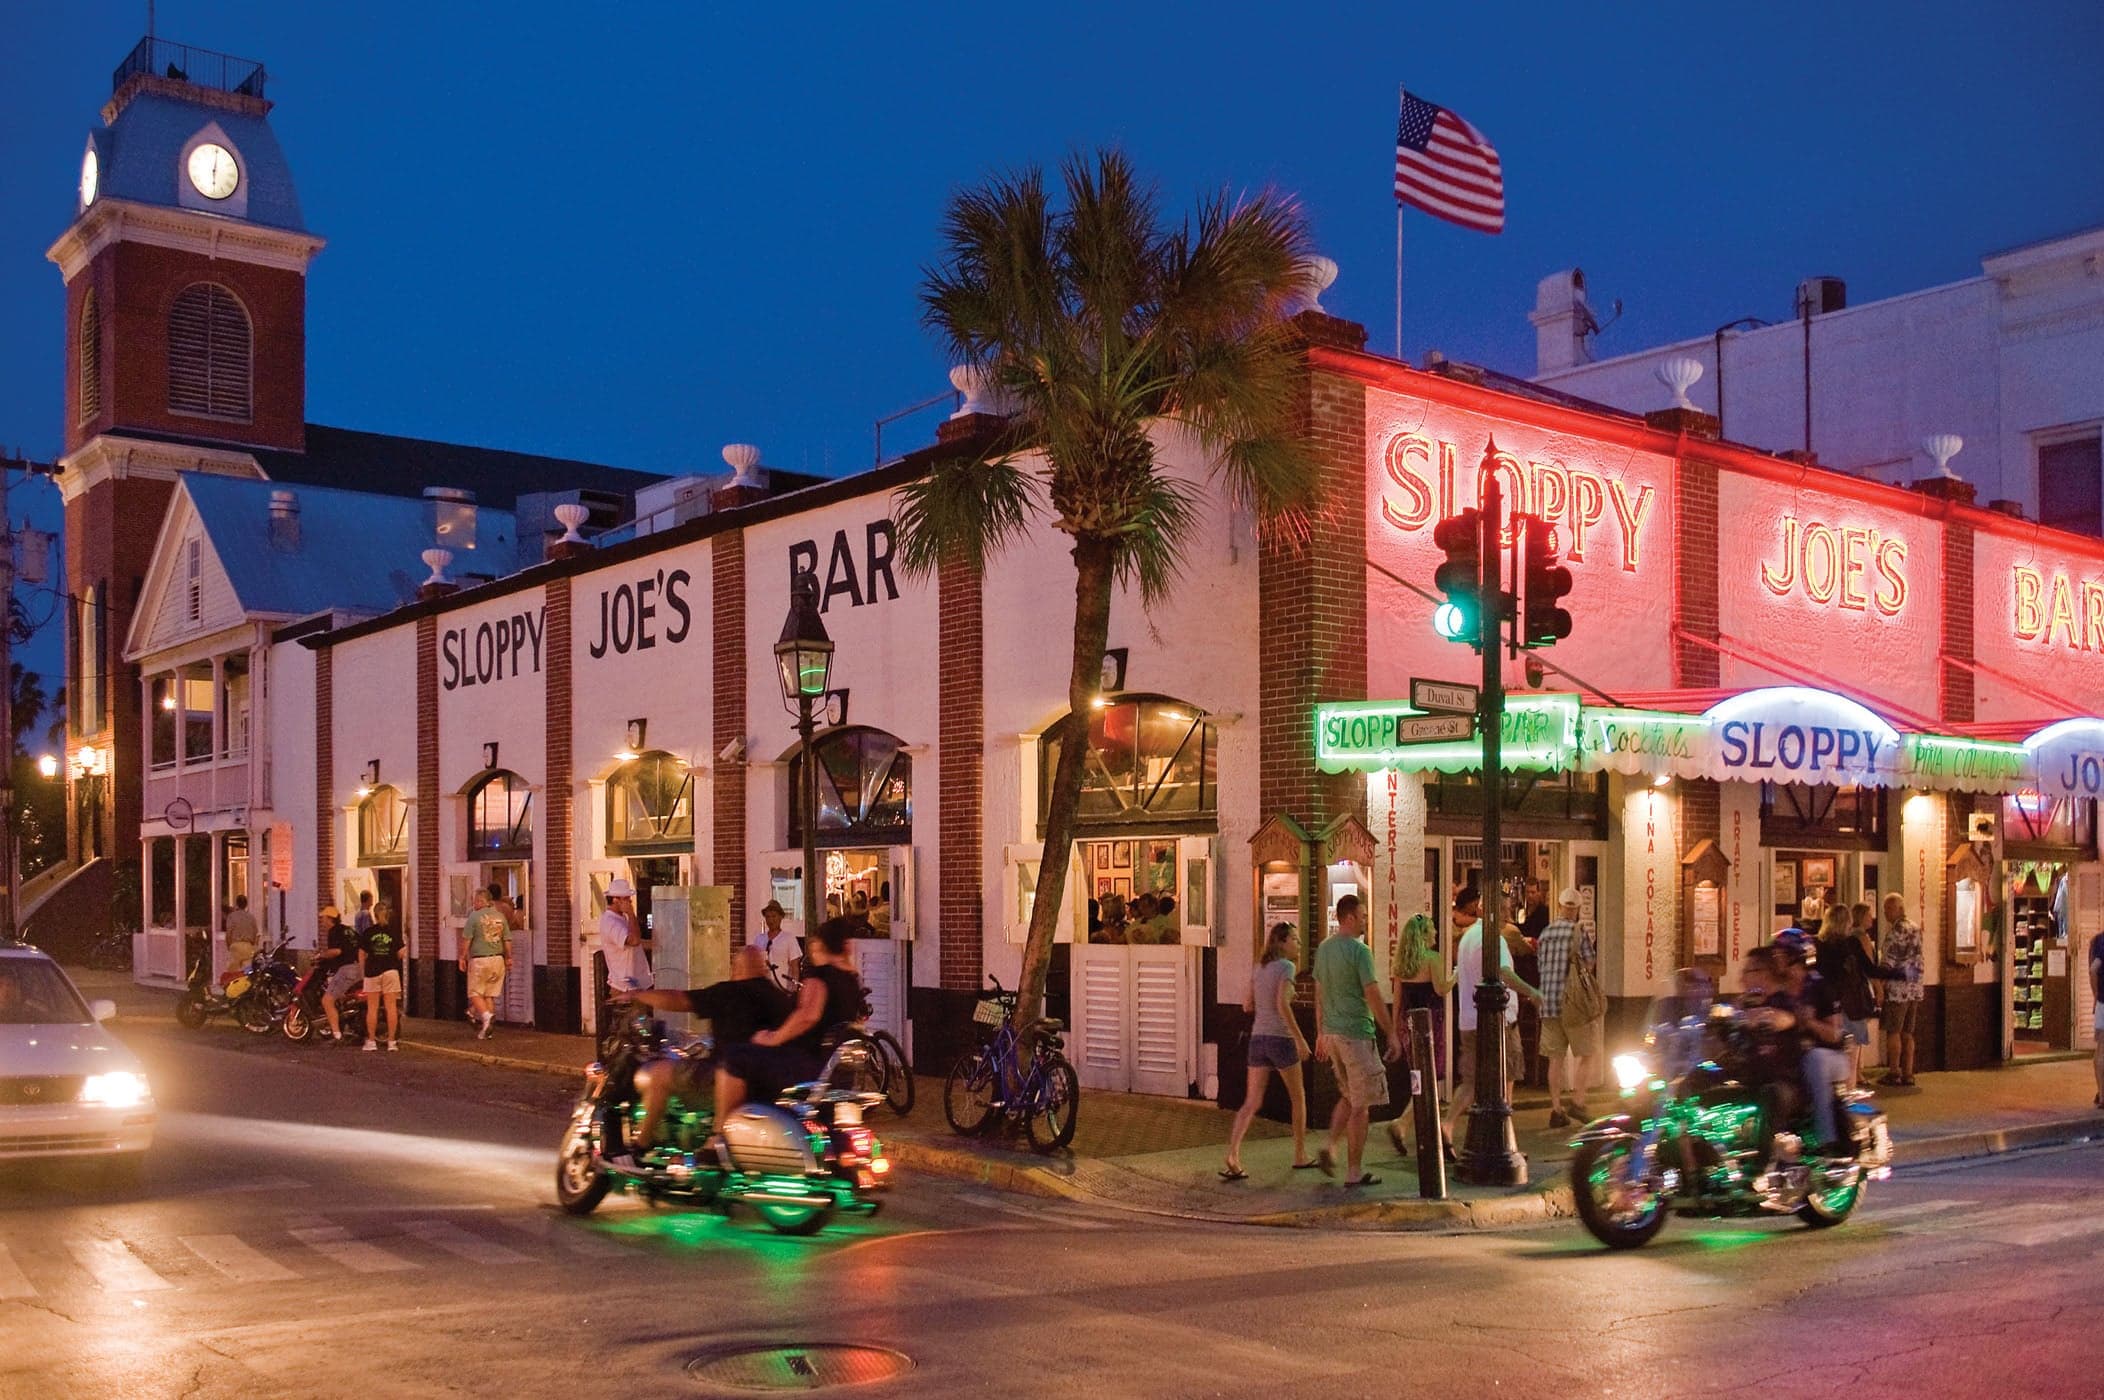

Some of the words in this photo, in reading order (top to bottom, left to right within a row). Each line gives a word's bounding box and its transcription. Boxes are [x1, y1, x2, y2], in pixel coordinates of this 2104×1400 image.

[1382, 431, 1654, 572] SLOPPY
[1761, 516, 1909, 617] JOE'S
[2014, 566, 2104, 653] BAR
[443, 605, 547, 690] SLOPPY
[590, 568, 691, 659] JOE'S
[789, 519, 900, 614] BAR
[1427, 688, 1454, 705] Duval
[1456, 693, 1465, 706] St
[1326, 715, 1395, 749] SLOPP
[1606, 722, 1694, 759] Cocktails
[1721, 720, 1885, 773] SLOPPY
[2061, 752, 2104, 794] JO
[1733, 810, 1741, 888] DRAFT
[1388, 768, 1398, 994] NTERTAINMET
[1646, 868, 1655, 980] COLADAS
[1732, 902, 1740, 961] BEER
